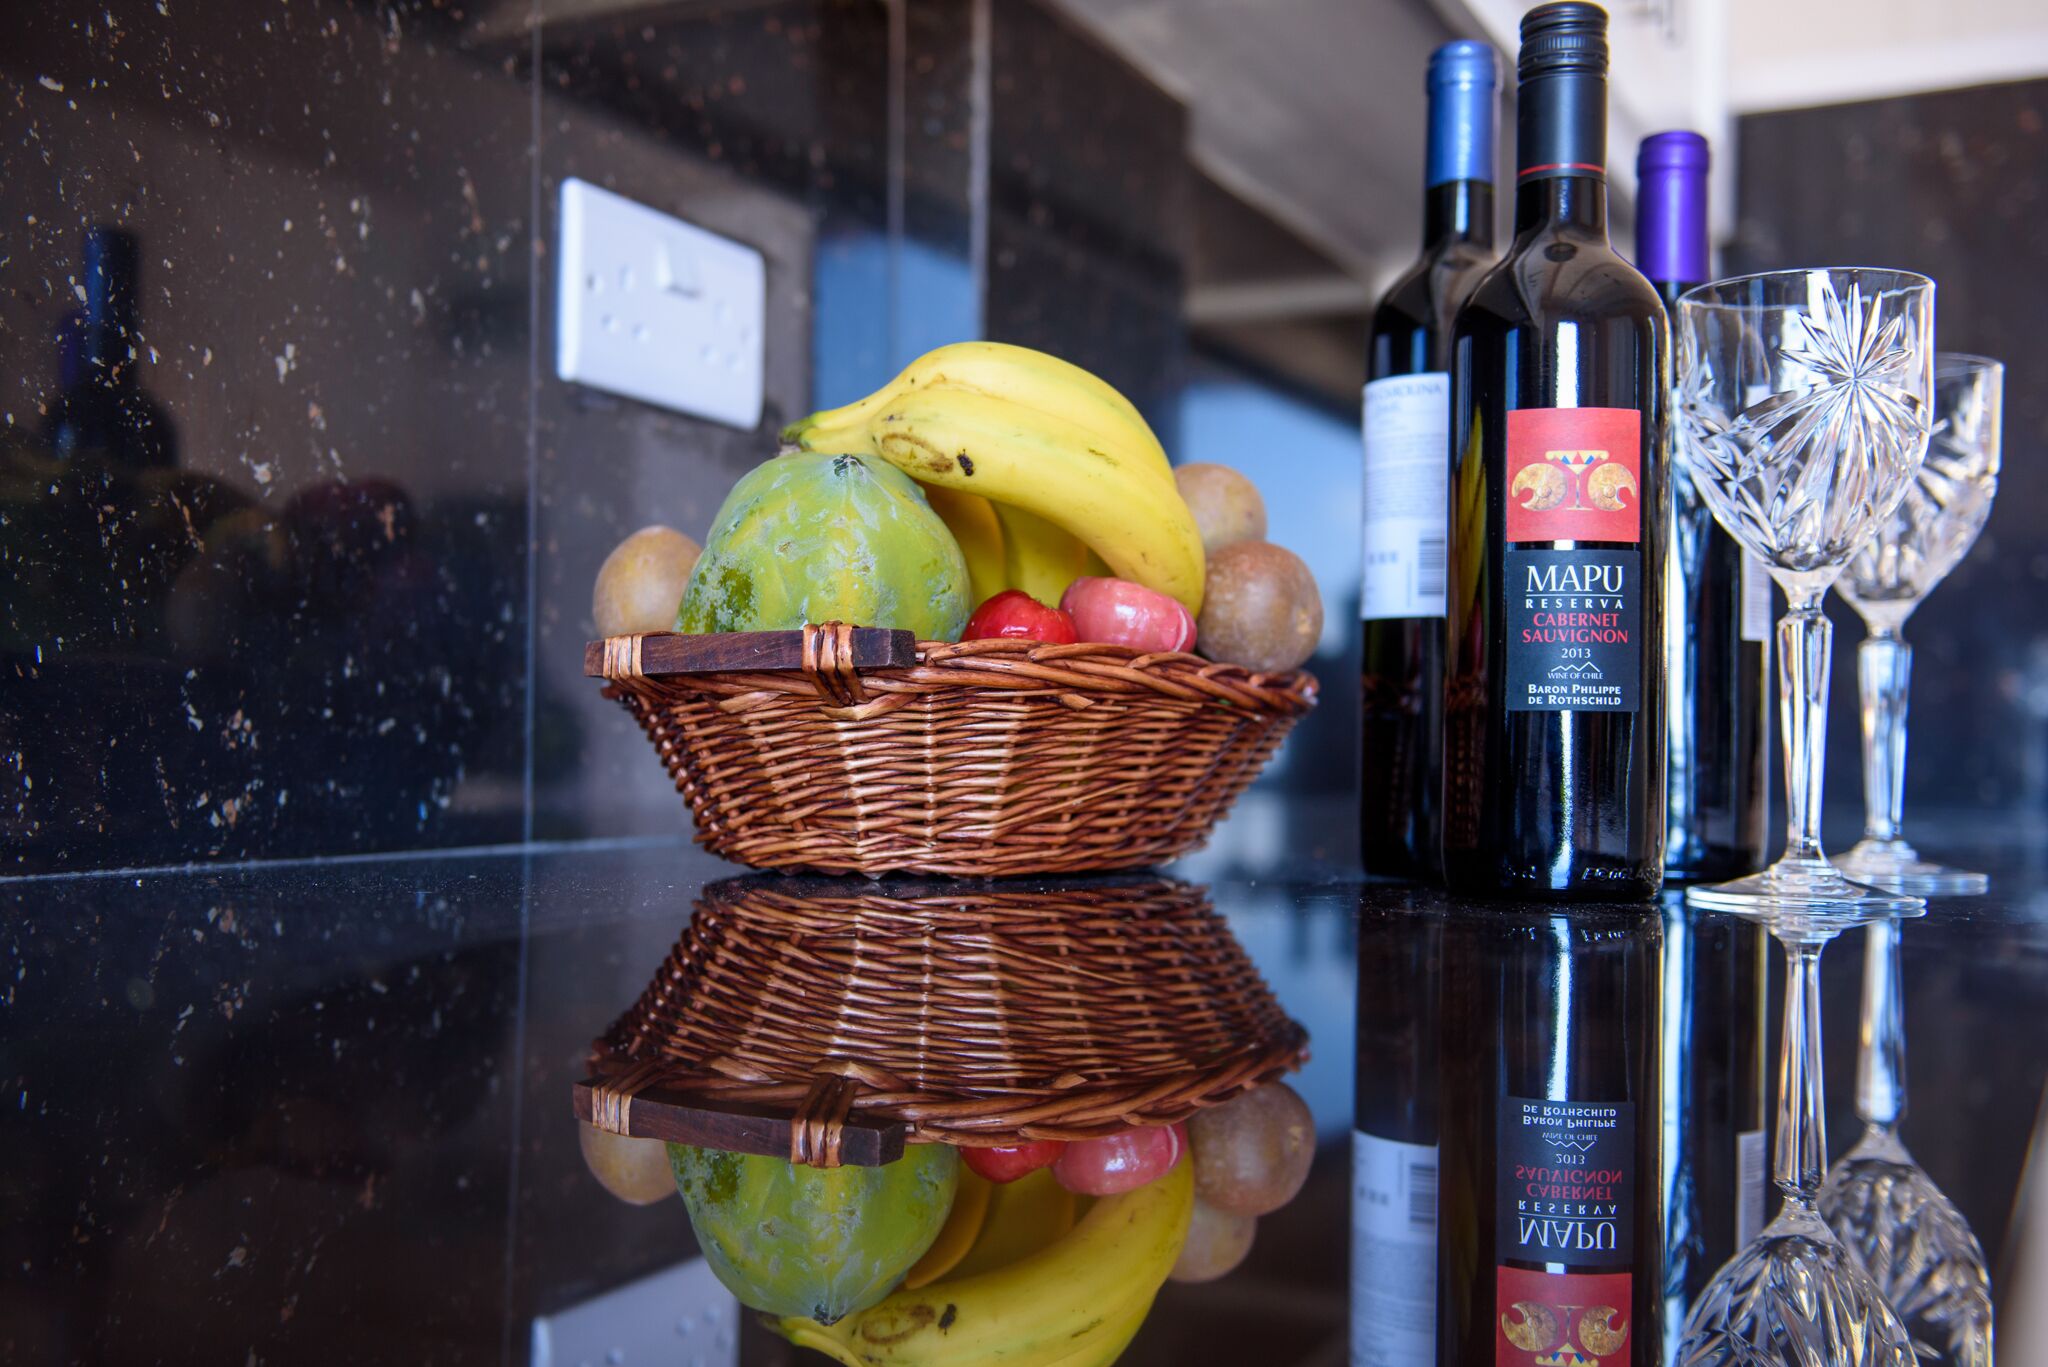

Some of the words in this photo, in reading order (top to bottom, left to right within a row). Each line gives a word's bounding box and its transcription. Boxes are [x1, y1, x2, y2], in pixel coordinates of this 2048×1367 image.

[1526, 565, 1623, 592] MAPU
[1526, 598, 1623, 609] RESERVA
[1533, 612, 1619, 627] CABERNET
[1522, 629, 1628, 643] SAUVIGNON
[1561, 648, 1591, 659] 2013
[1547, 672, 1568, 680] WINE
[1569, 672, 1580, 680] OF
[1582, 672, 1604, 680] CHILE
[1528, 684, 1568, 694] BARON
[1572, 684, 1621, 695] PHILIPPE
[1528, 696, 1543, 705] DE
[1548, 695, 1621, 705] ROTHSCHILD
